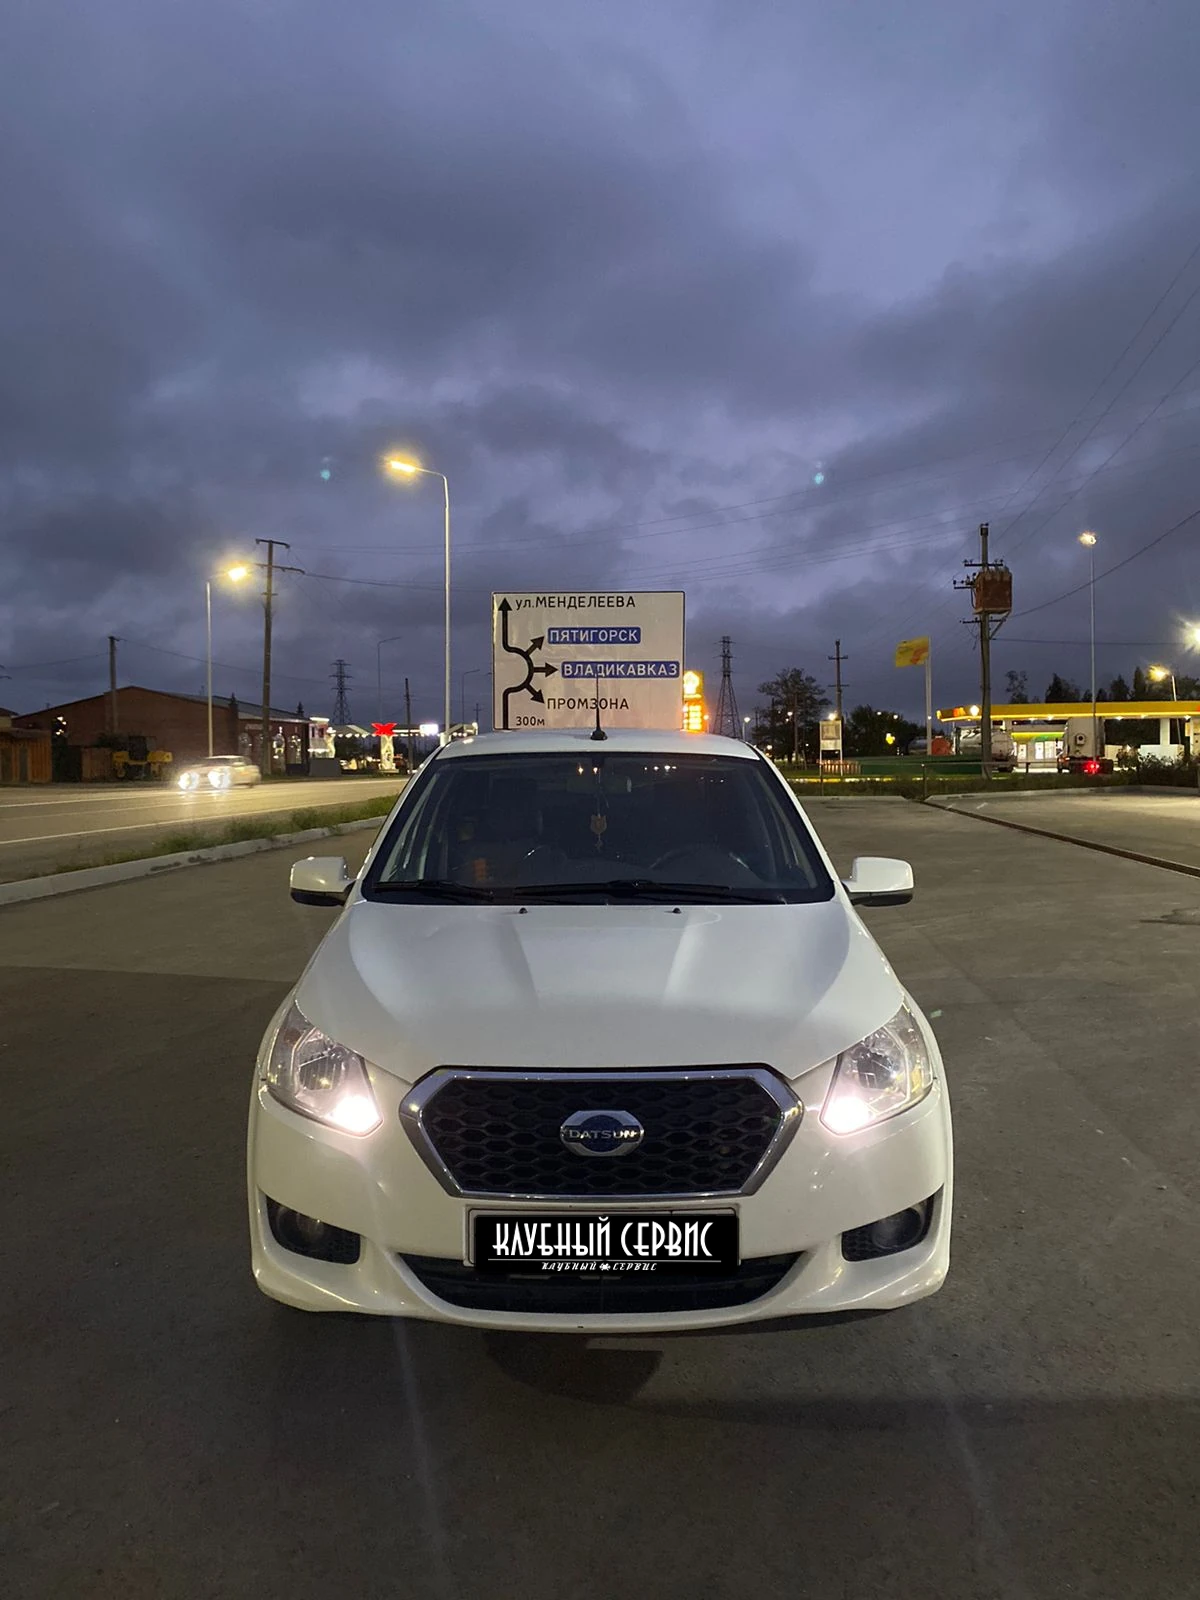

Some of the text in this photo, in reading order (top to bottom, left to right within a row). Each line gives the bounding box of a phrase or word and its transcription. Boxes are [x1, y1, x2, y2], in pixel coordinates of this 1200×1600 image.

[549, 629, 638, 642] ПЯТИГОРСК
[563, 663, 678, 677] ВЛАДИКАВКАЗ
[547, 698, 629, 710] ПРОМЗОНА
[516, 716, 545, 726] 300м
[569, 1129, 637, 1139] DATSUN
